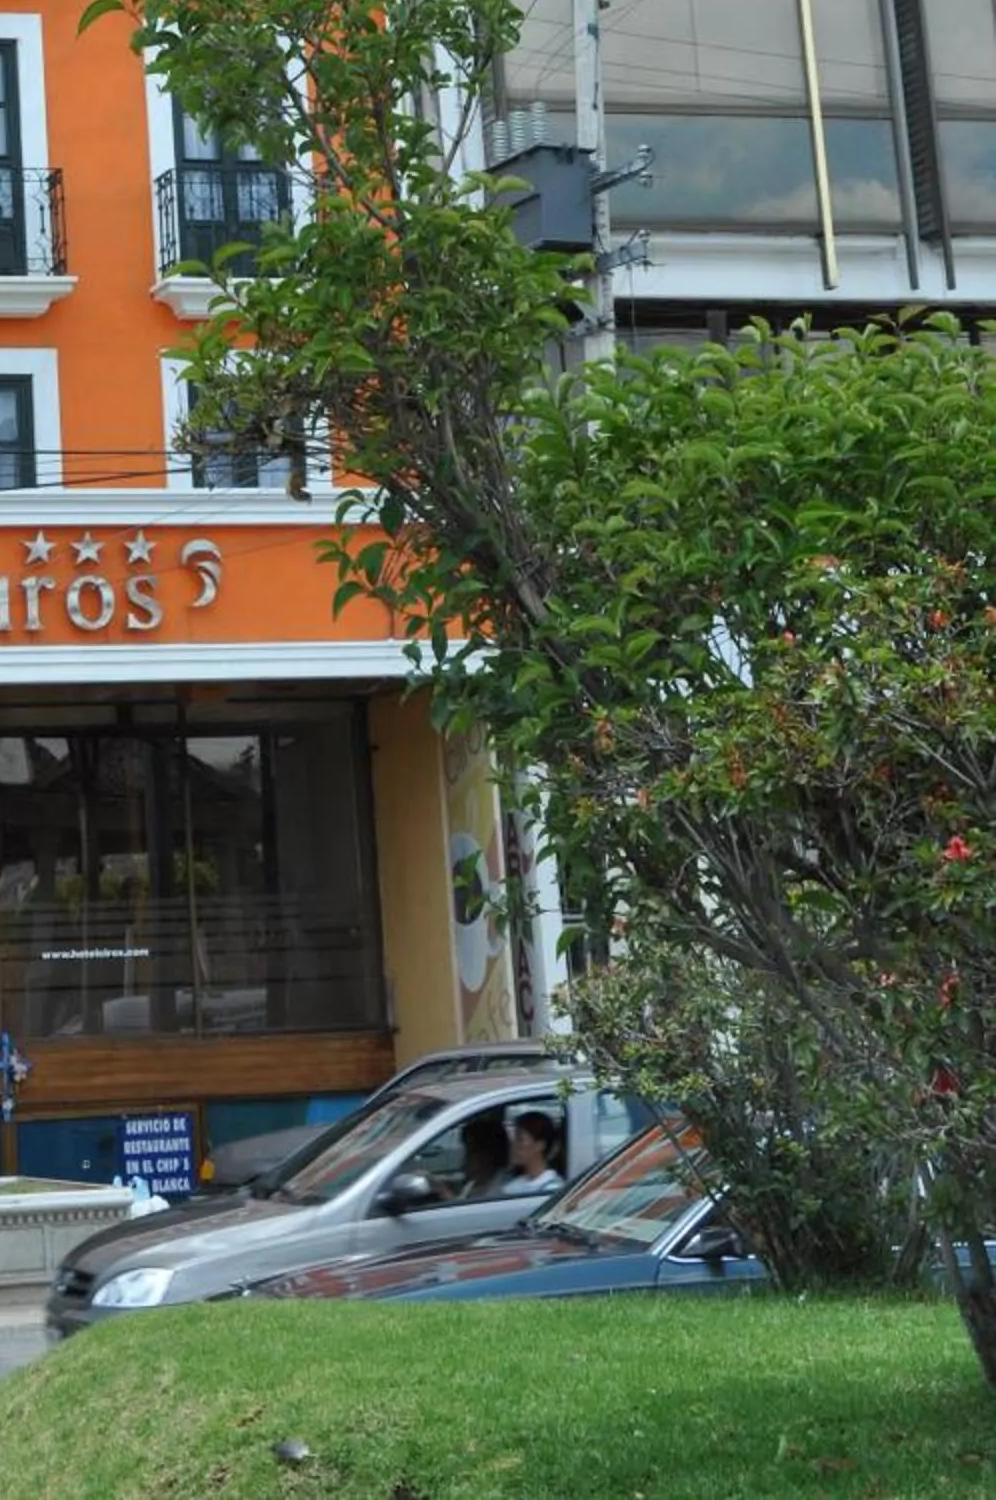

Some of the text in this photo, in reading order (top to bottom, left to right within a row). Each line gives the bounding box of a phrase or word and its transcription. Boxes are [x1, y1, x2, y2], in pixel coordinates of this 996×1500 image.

[125, 1117, 187, 1135] SERVICIO DE
[124, 1137, 190, 1154] RESTAURANTE
[125, 1160, 140, 1174] EN
[142, 1159, 154, 1173] EL
[151, 1177, 191, 1193] BLANCA
